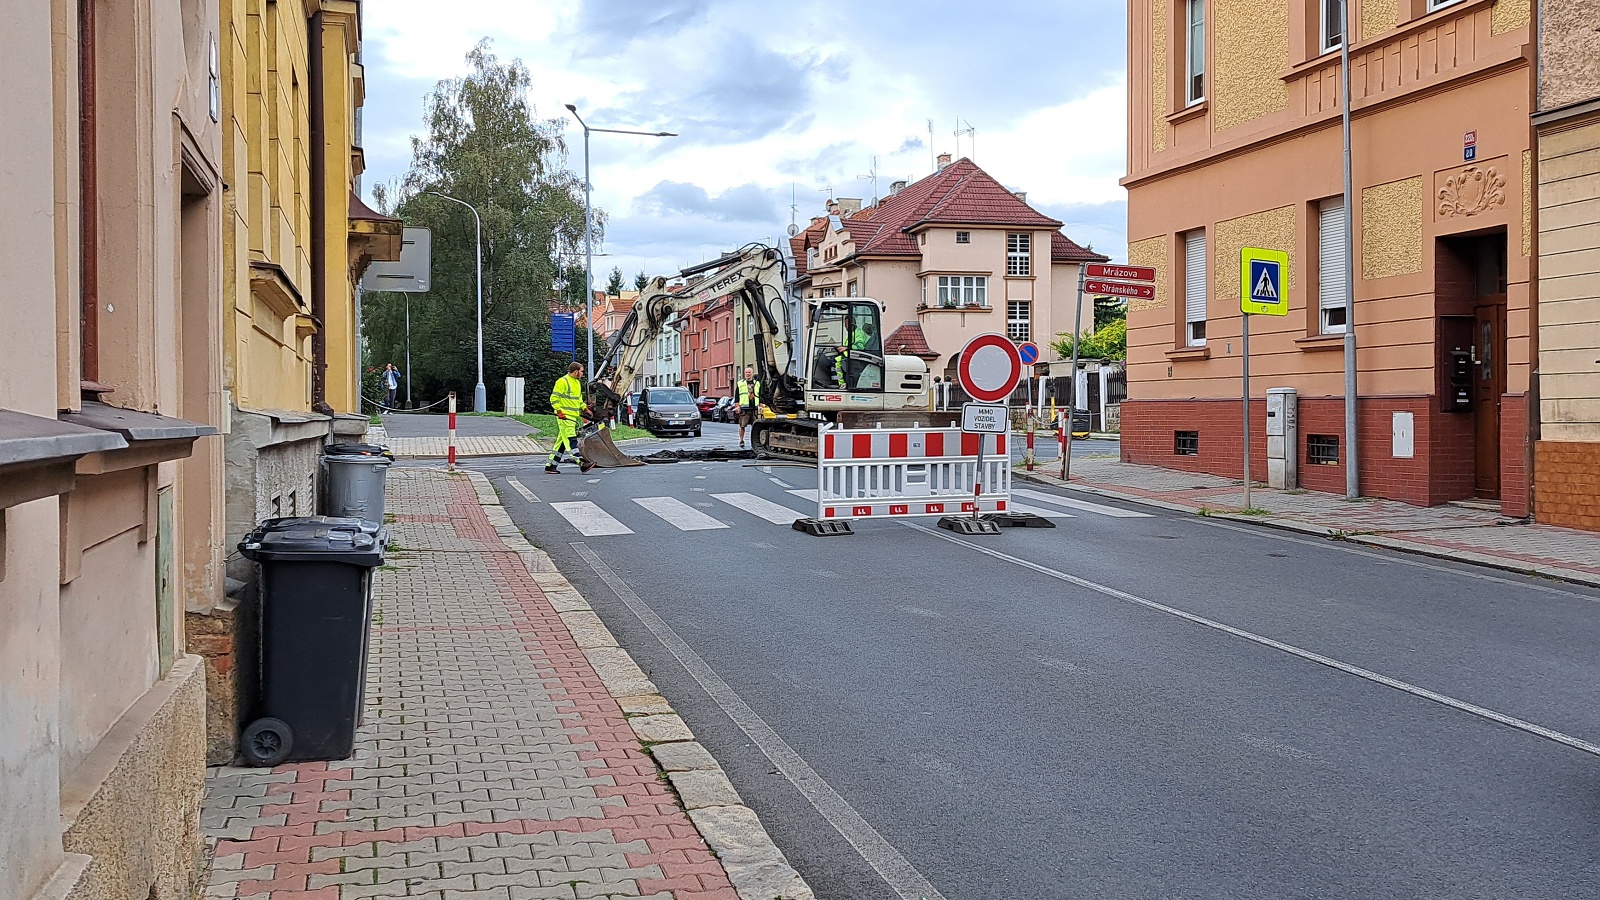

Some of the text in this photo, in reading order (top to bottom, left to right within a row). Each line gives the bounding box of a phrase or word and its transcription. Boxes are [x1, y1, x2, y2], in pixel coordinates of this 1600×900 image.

[1102, 266, 1138, 278] Mrázova
[711, 270, 745, 293] TEREX
[1101, 283, 1138, 295] Stránského
[973, 415, 997, 423] VOZIDEL
[973, 422, 996, 430] STAVBY
